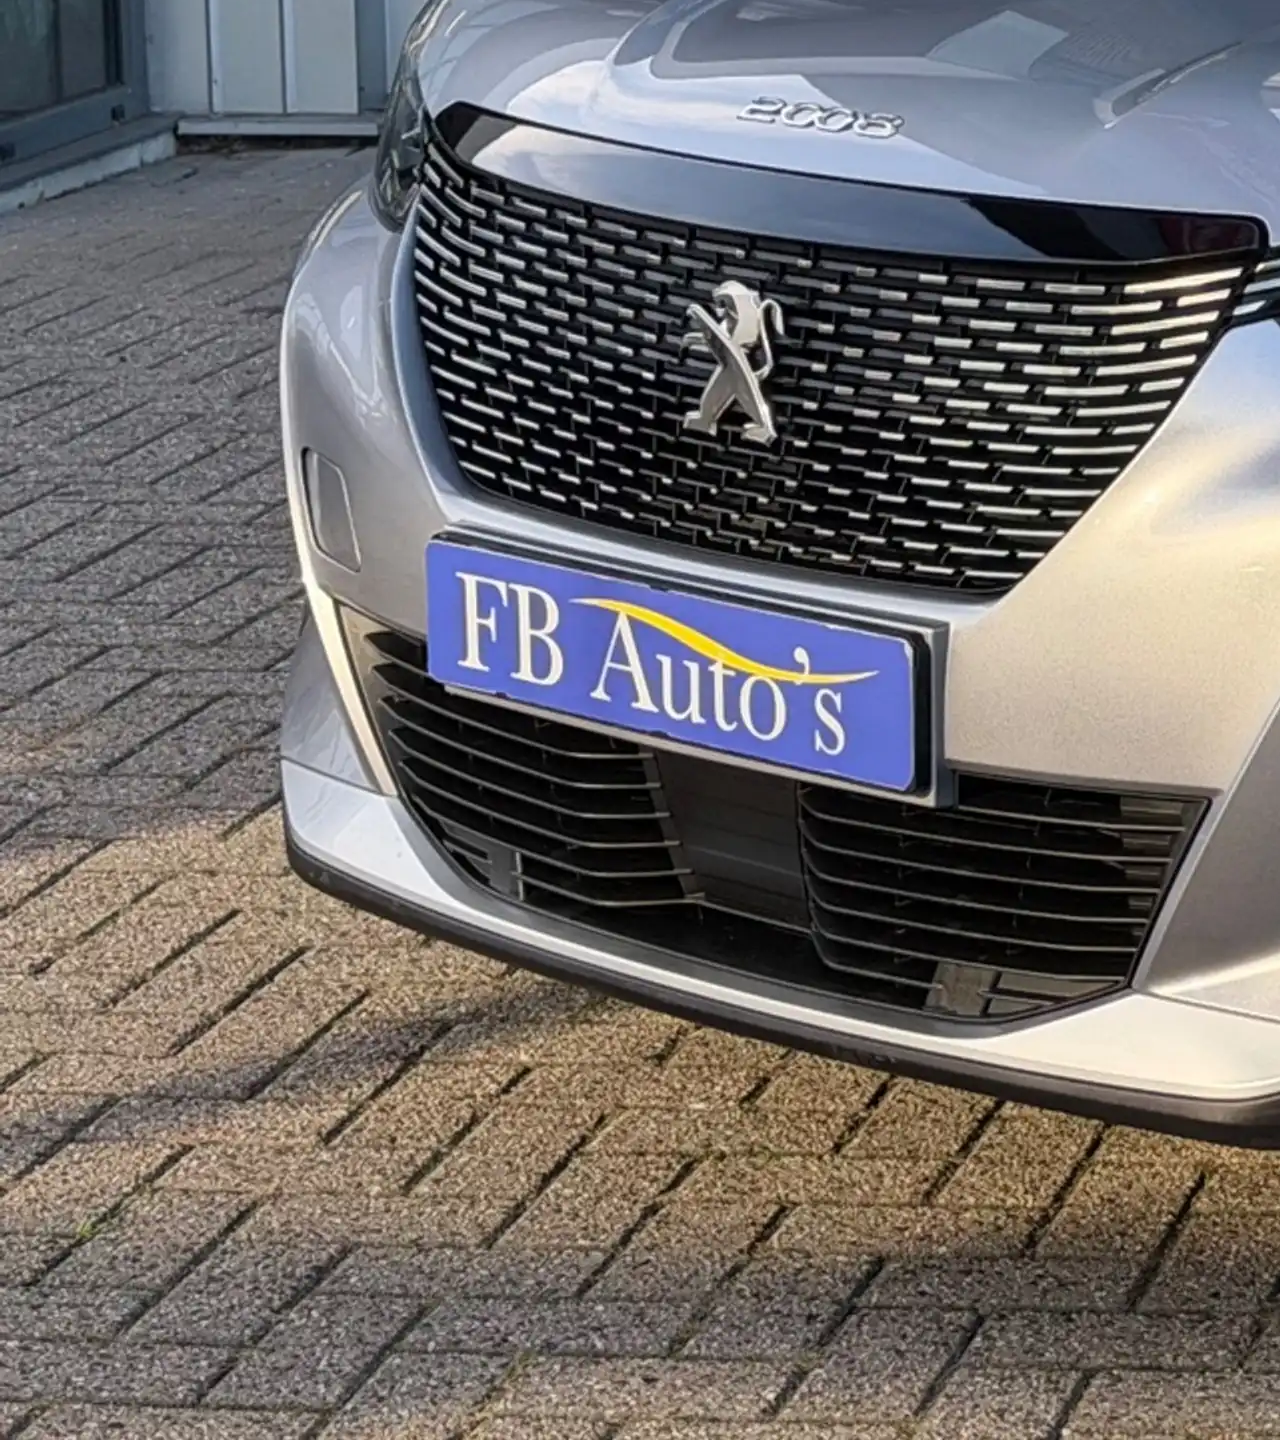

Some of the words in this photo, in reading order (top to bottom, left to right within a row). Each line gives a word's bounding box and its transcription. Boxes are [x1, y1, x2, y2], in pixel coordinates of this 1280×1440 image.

[736, 96, 905, 139] 2008
[455, 570, 564, 686] FB
[589, 609, 847, 757] Auto's
